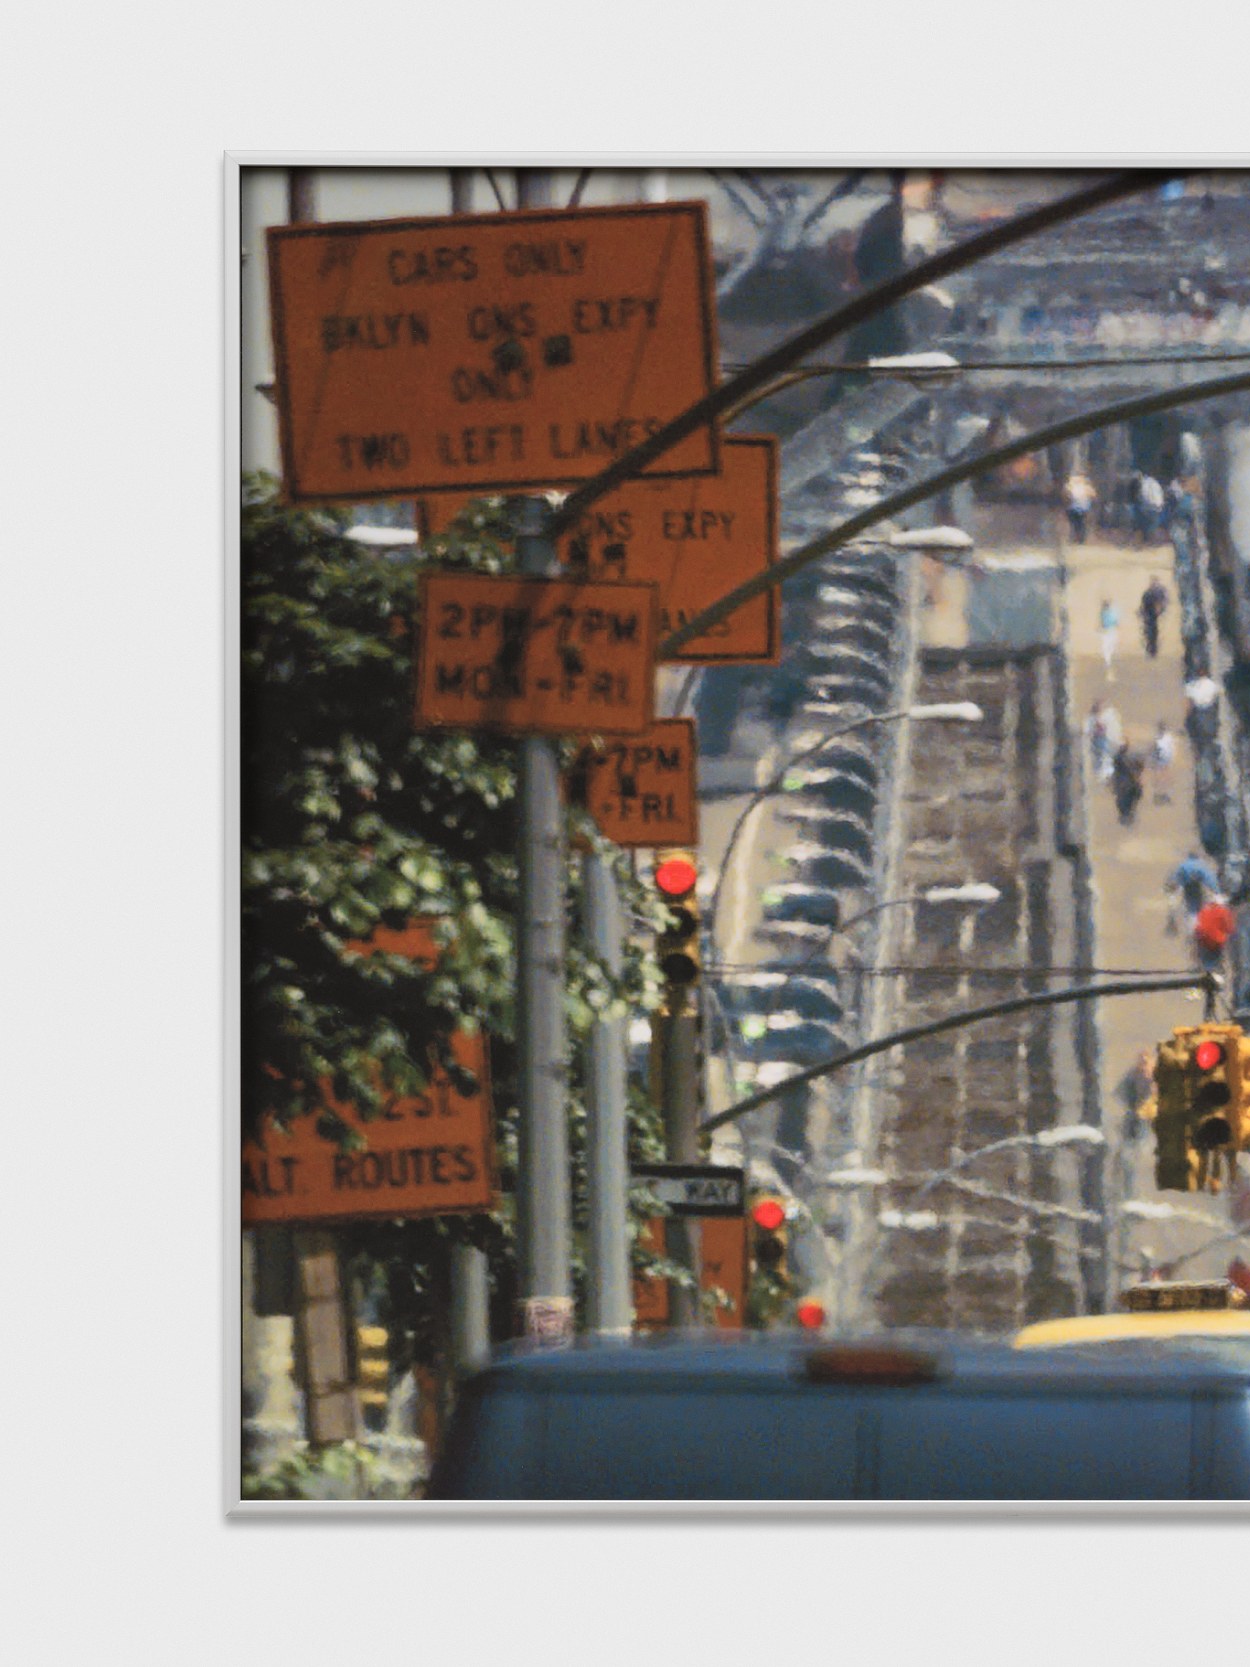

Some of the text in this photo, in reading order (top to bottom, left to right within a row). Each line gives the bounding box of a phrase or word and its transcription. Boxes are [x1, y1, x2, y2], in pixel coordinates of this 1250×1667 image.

[388, 239, 588, 285] CARS ONLY
[320, 312, 432, 352] BKLYN
[571, 297, 661, 335] EXPY
[451, 366, 535, 403] ONLY
[335, 431, 411, 472] TWO
[436, 423, 526, 467] LEFT
[661, 509, 737, 542] EXPY
[332, 1147, 477, 1192] ROUTES
